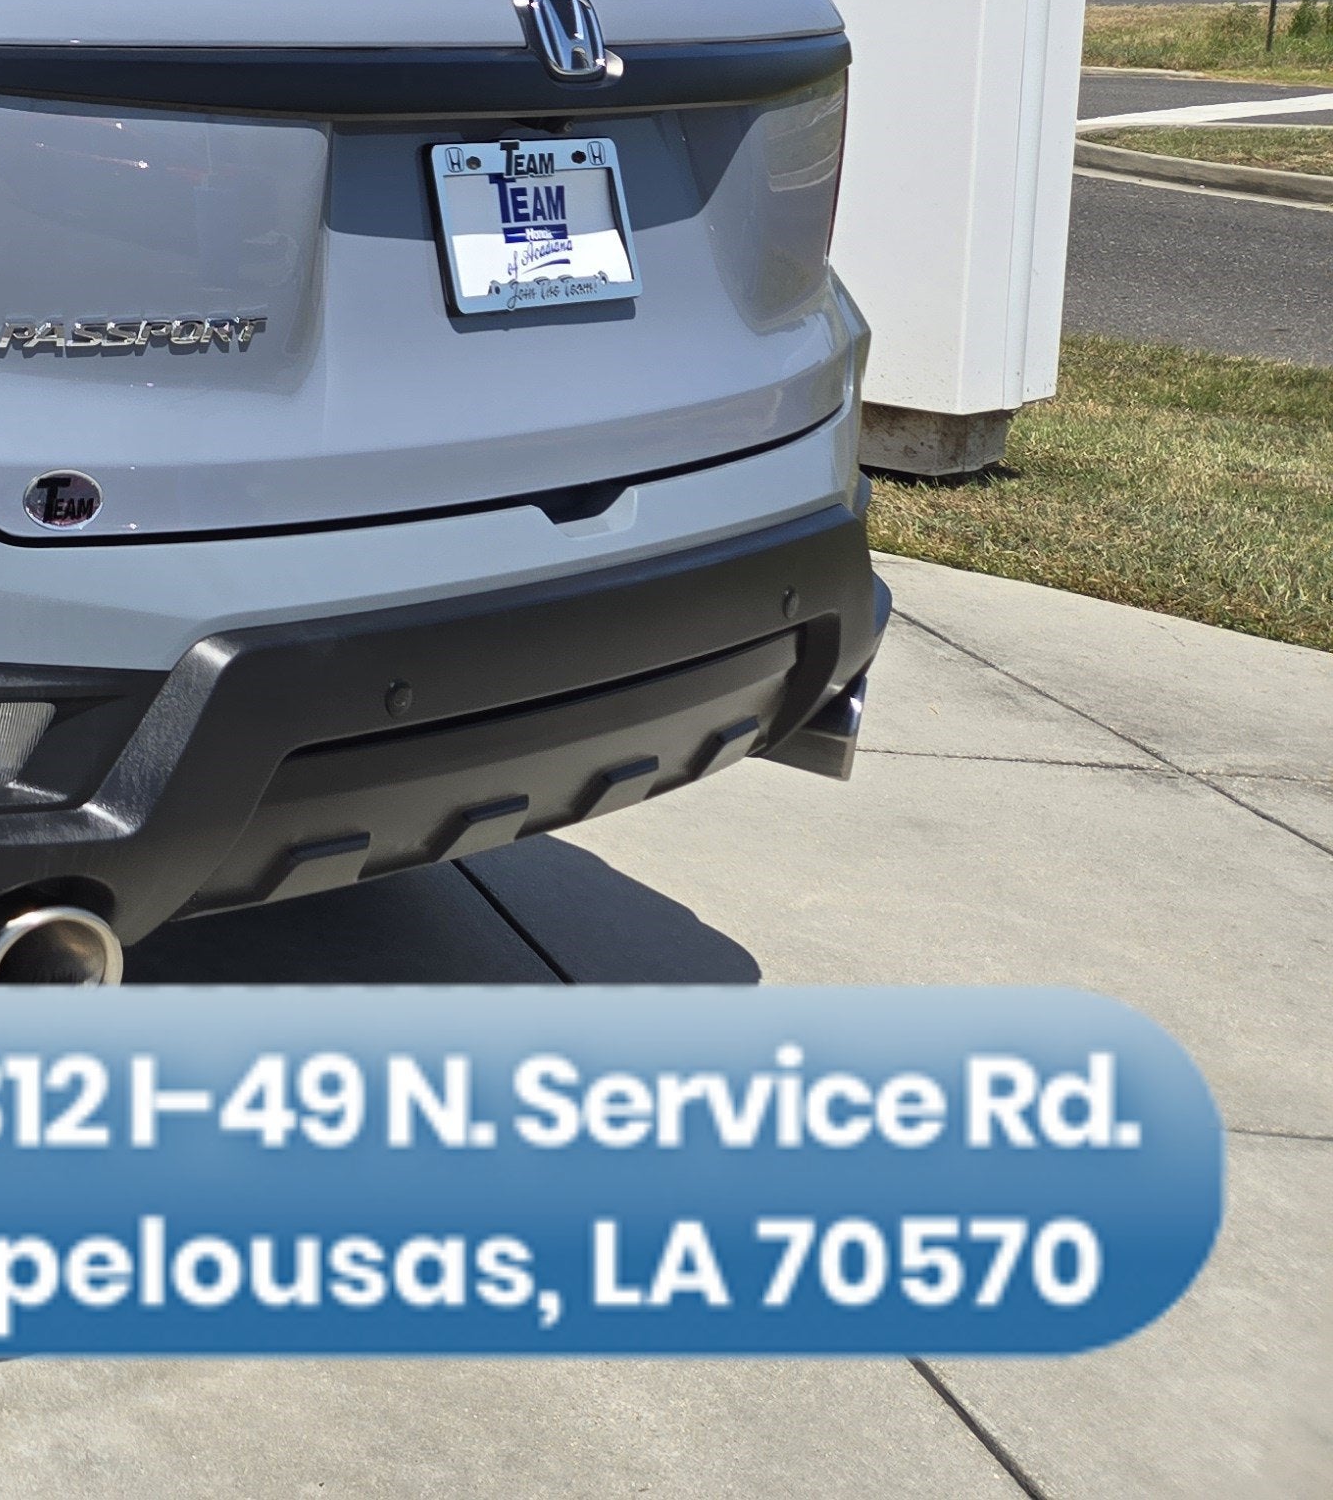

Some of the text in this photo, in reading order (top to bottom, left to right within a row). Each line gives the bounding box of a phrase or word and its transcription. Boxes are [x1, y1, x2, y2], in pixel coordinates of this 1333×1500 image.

[499, 140, 555, 177] TEAM
[489, 173, 567, 223] TEAM
[35, 476, 95, 524] TEAM
